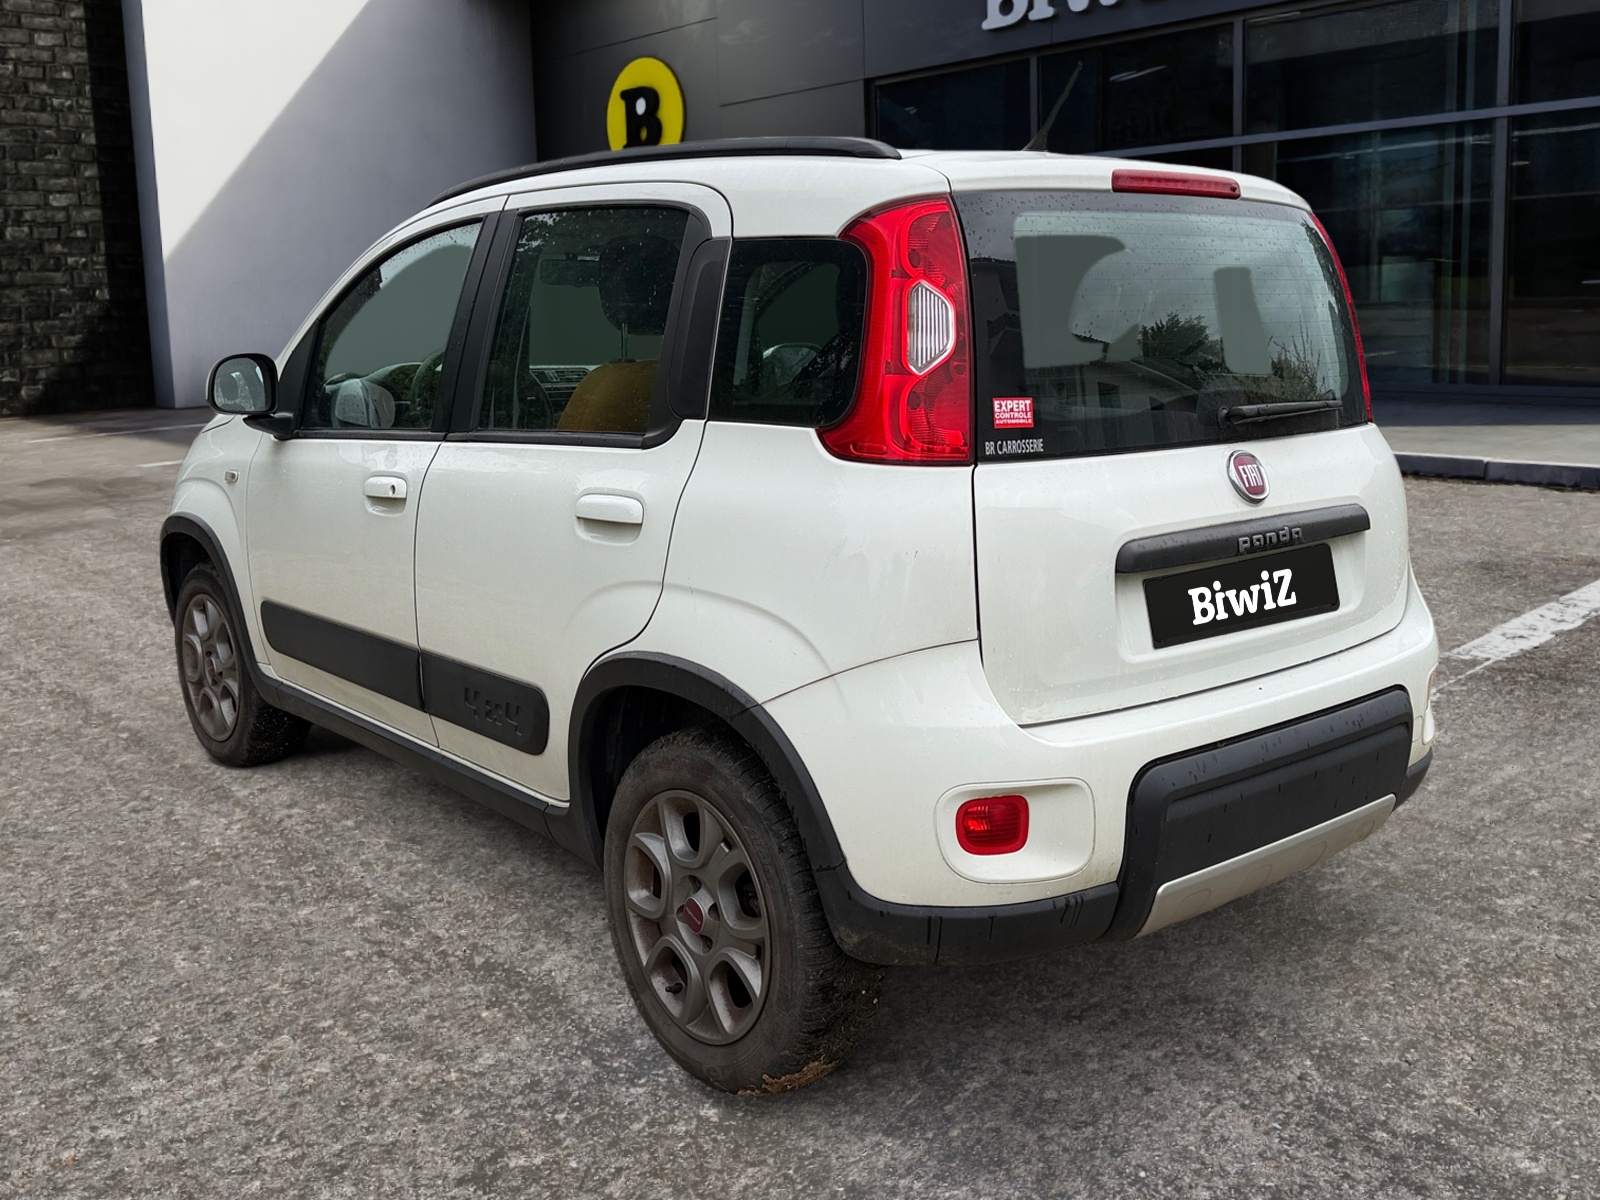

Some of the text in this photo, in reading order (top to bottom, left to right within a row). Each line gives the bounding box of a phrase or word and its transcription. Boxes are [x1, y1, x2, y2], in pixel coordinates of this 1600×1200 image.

[620, 86, 662, 148] B
[994, 400, 1031, 412] EXPERT
[985, 438, 1044, 455] BR CARROSSERIE
[1238, 464, 1264, 488] FIAT
[1238, 526, 1302, 553] panda
[1187, 568, 1297, 626] BiwiZ
